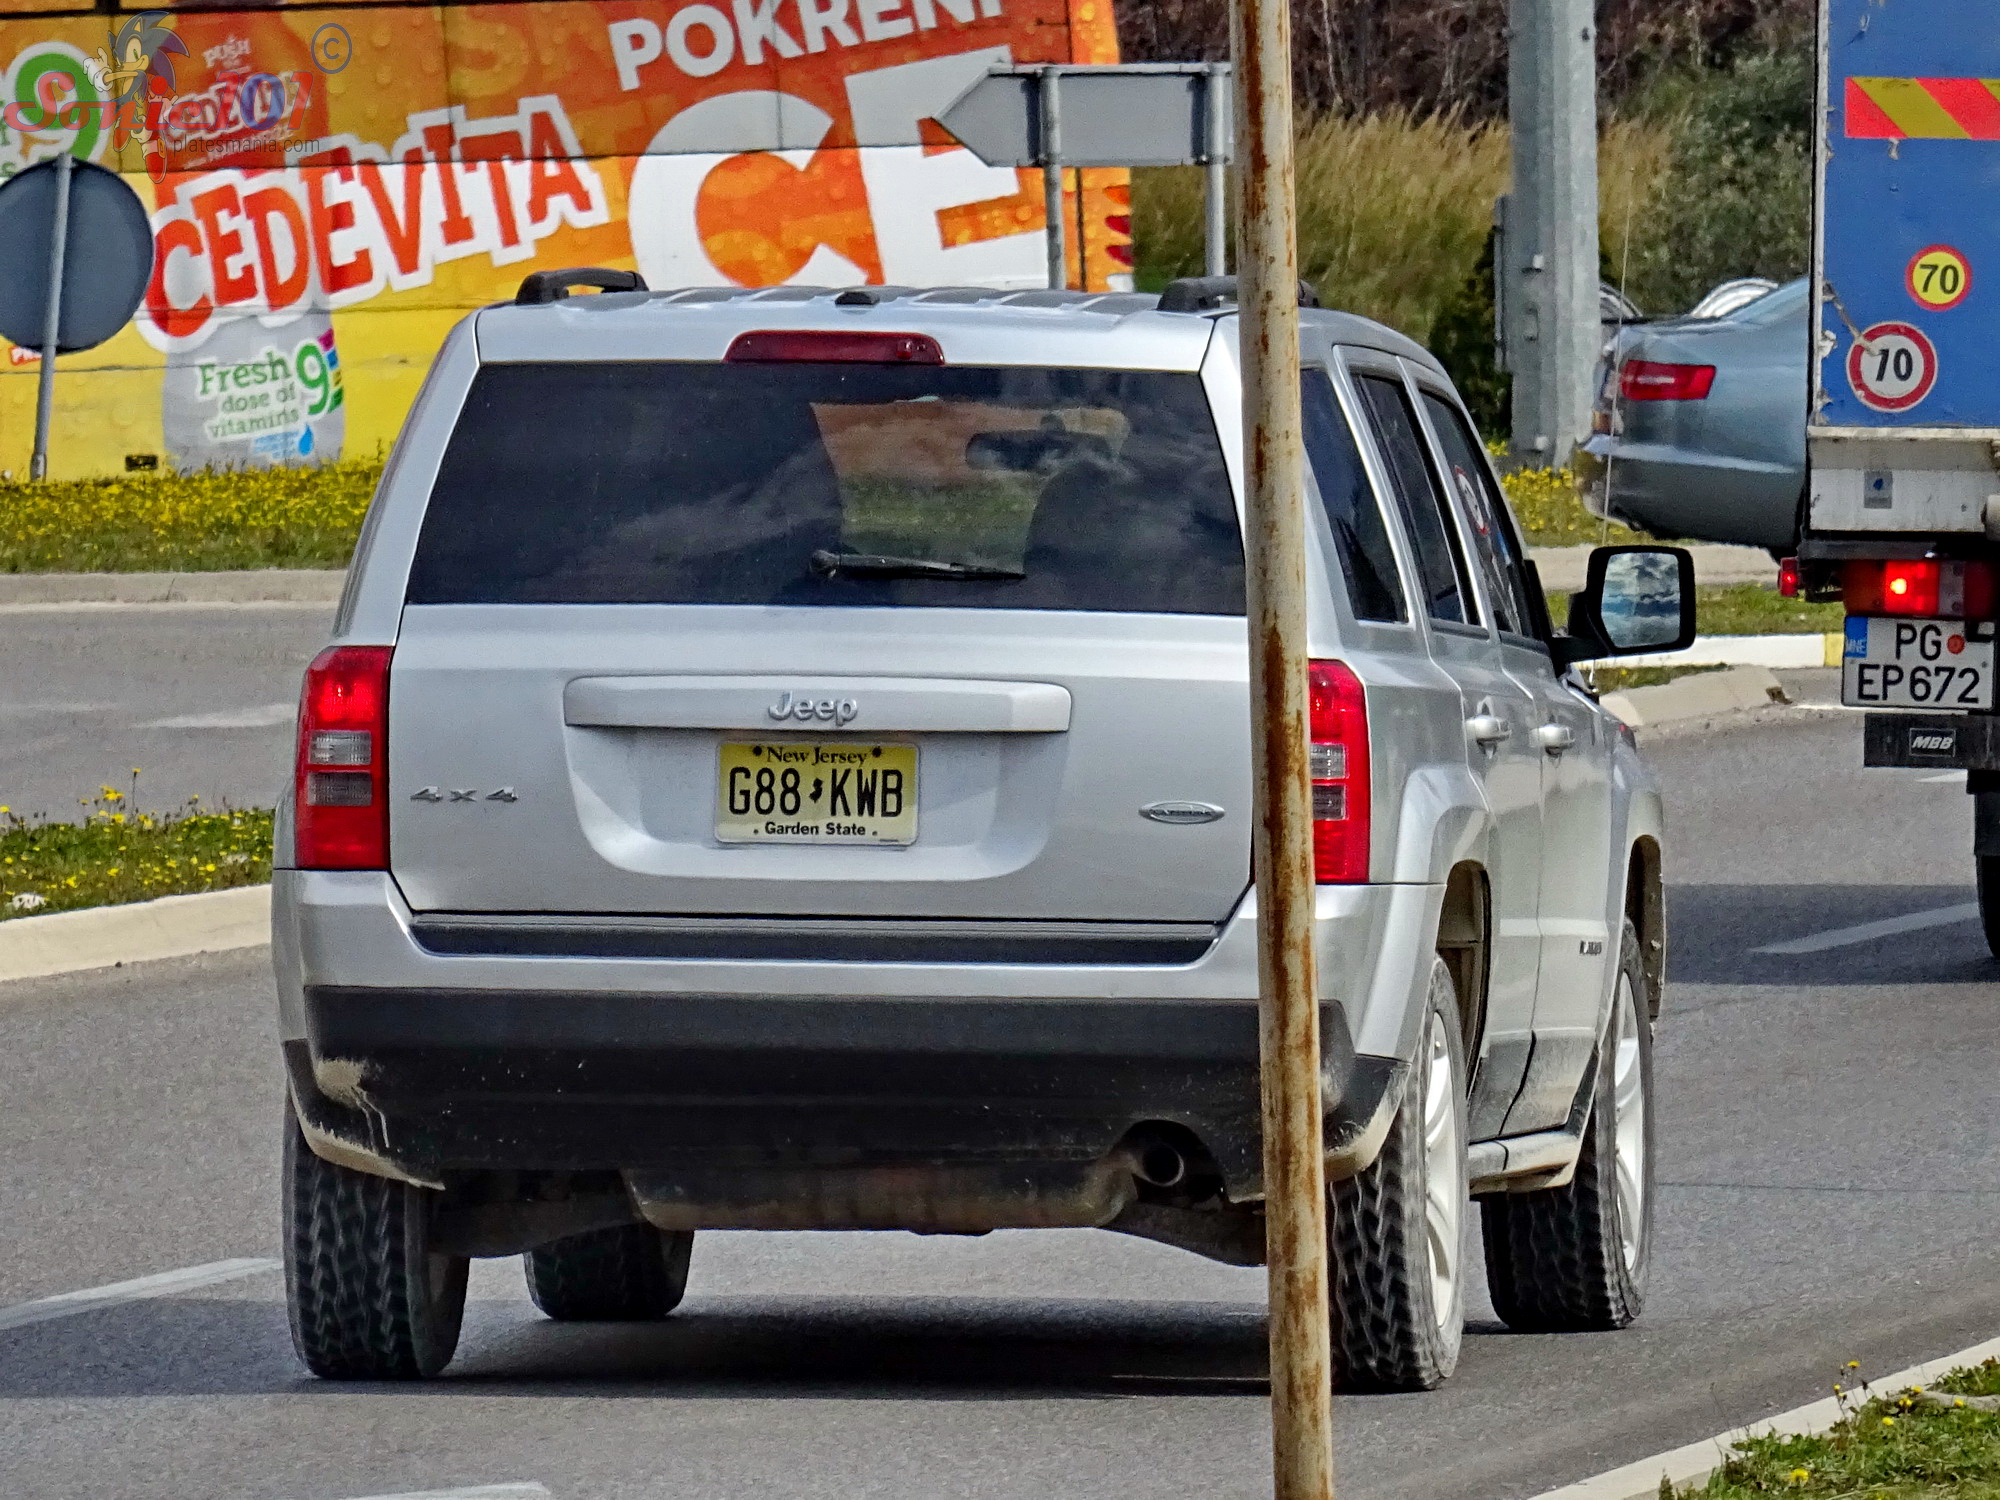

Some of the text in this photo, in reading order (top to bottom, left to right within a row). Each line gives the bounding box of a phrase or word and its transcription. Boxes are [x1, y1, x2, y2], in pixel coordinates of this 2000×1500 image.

[610, 0, 1002, 91] POKRE
[145, 111, 593, 338] CEDEVITA
[1919, 264, 1960, 295] 70
[200, 343, 330, 415] Fresh 9
[1875, 348, 1914, 382] 70
[222, 382, 297, 413] dose of
[208, 409, 300, 438] vitamins
[1895, 623, 1942, 661] PG
[1858, 664, 1980, 704] EP672
[768, 691, 858, 726] Jeep
[767, 747, 867, 766] New Jersey
[1912, 735, 1953, 750] MBB
[729, 767, 903, 818] G88 KWB
[764, 822, 866, 836] Garden State
